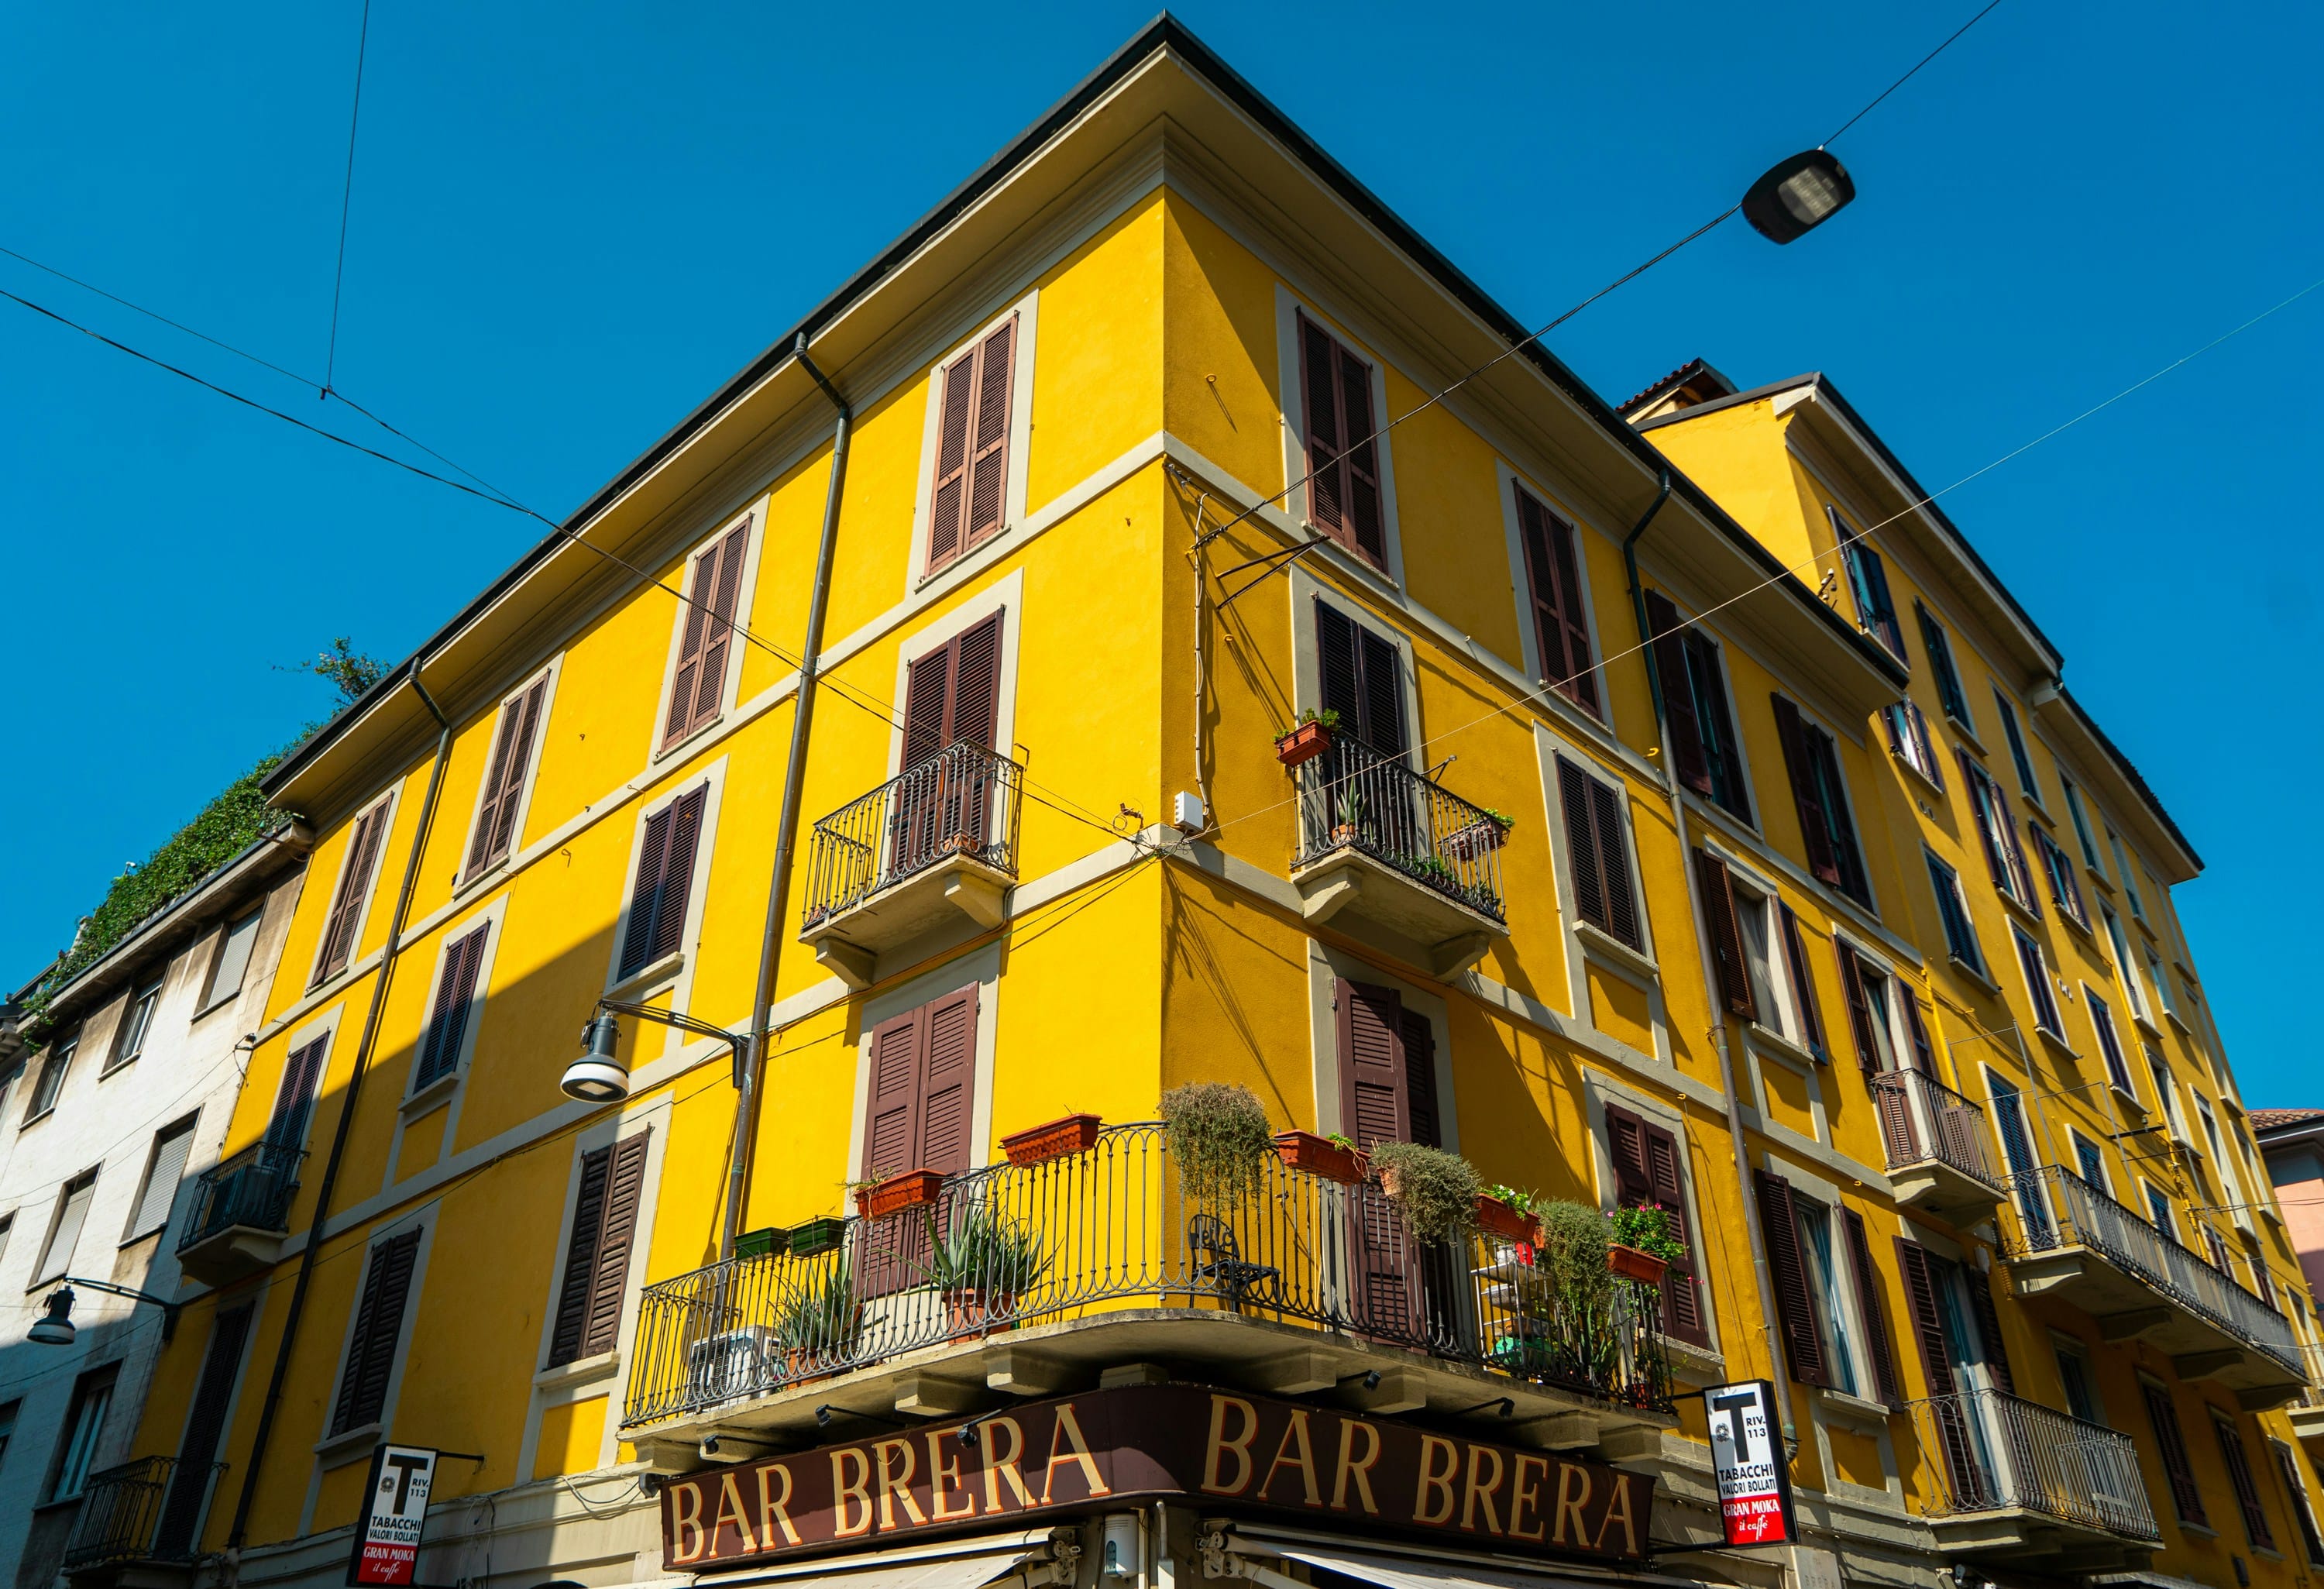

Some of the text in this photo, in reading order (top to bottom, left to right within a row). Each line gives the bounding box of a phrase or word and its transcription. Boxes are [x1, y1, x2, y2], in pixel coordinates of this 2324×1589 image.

[1713, 1391, 1757, 1463] T
[1745, 1415, 1766, 1427] RIV.
[1747, 1428, 1766, 1439] 113
[1200, 1393, 1640, 1556] BAR BRERA
[1719, 1463, 1773, 1482] TABACCHI
[388, 1453, 429, 1515] T
[412, 1478, 429, 1488] RIV.
[669, 1403, 1111, 1565] BAR BRERA
[1721, 1478, 1776, 1495] VALORI BOLLATI
[410, 1489, 427, 1498] 113
[1723, 1499, 1780, 1517] GRAN MOKA
[372, 1516, 421, 1532] TABACCHI
[1739, 1520, 1745, 1531] il
[370, 1530, 419, 1543] VALORI BOLLATI
[364, 1546, 414, 1561] GRAN MOKA
[373, 1562, 380, 1572] il
